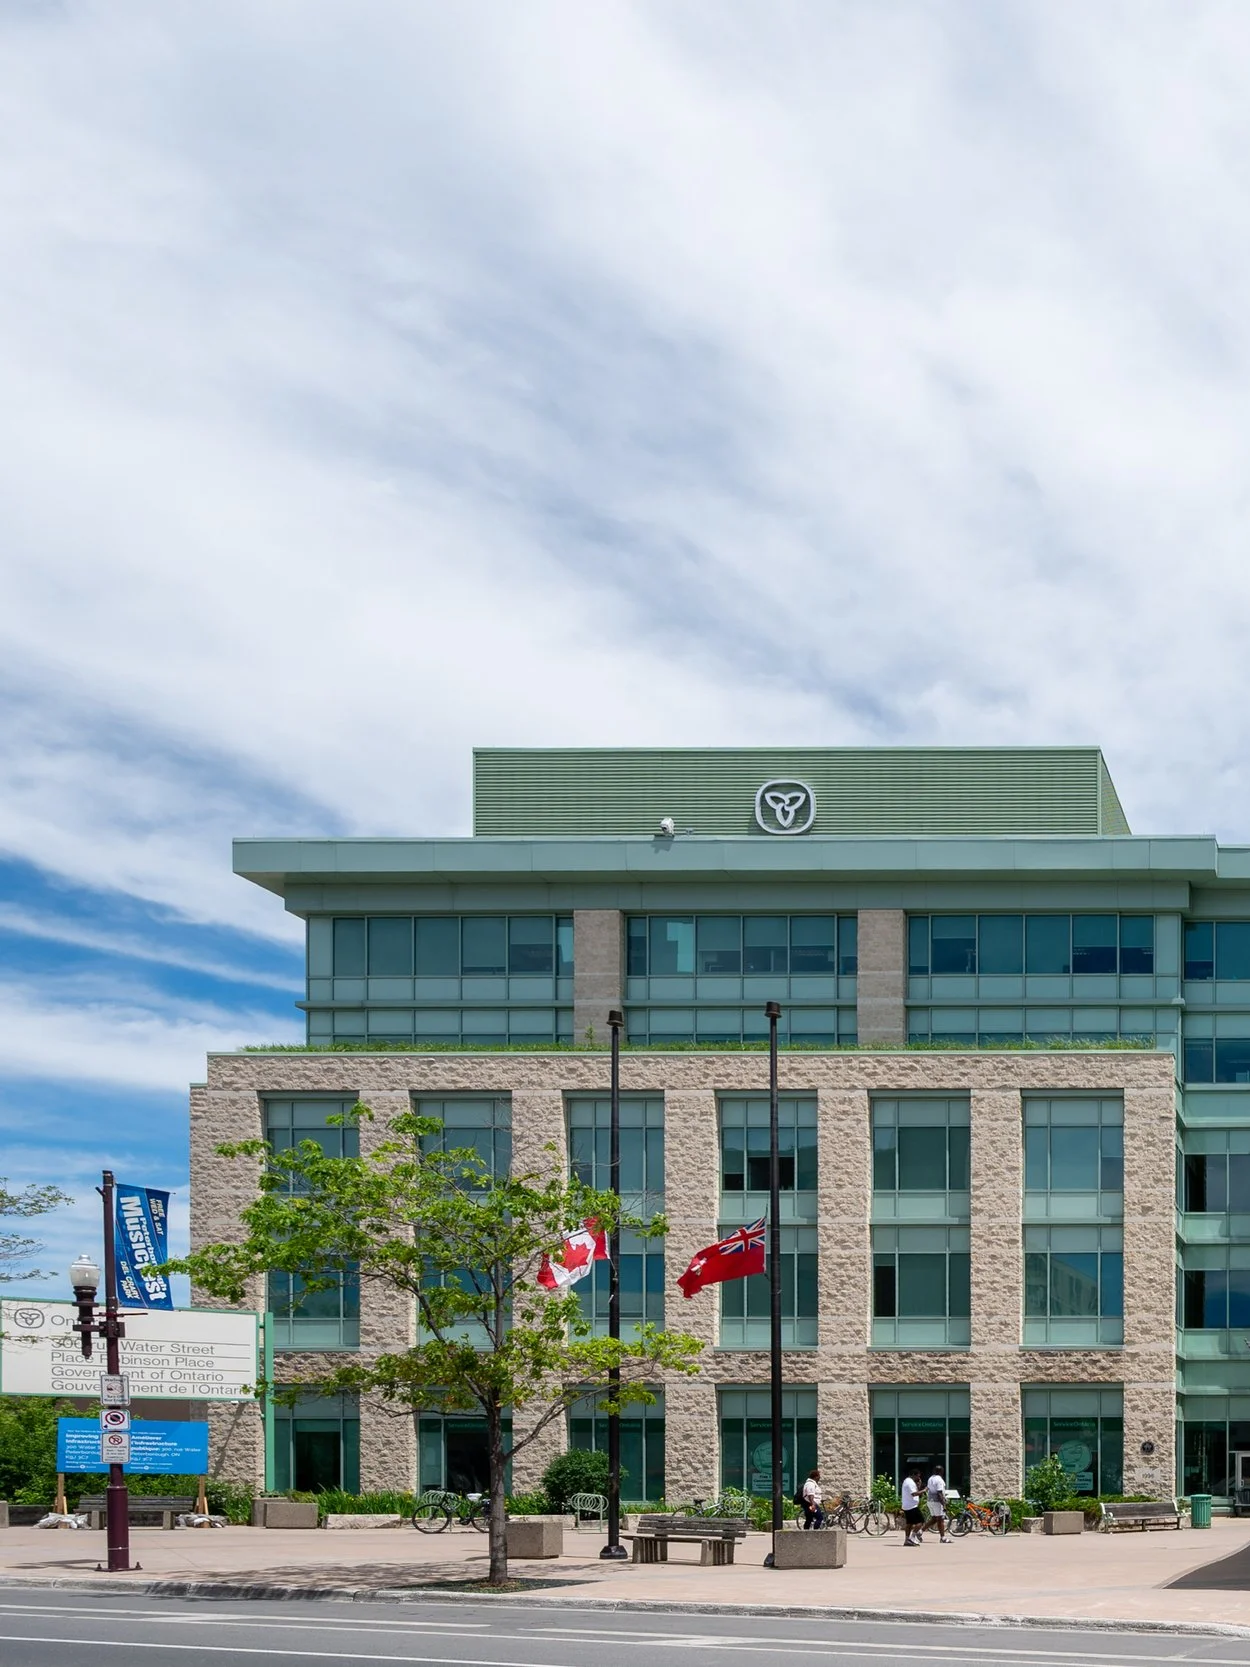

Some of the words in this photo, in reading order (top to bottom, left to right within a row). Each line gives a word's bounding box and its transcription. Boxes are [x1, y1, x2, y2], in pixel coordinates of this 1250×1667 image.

[149, 1198, 158, 1215] WED
[154, 1221, 164, 1236] SAT
[155, 1199, 165, 1217] FREE
[120, 1260, 128, 1276] DEL
[125, 1276, 141, 1300] CRARY
[120, 1279, 135, 1299] PARK
[120, 1340, 165, 1353] Water
[170, 1343, 215, 1355] Street
[51, 1351, 94, 1364] Place
[100, 1353, 170, 1367] Rbinson
[175, 1356, 215, 1369] Place
[51, 1365, 145, 1380] Governent
[150, 1370, 166, 1380] of
[170, 1370, 224, 1382] Ontario
[51, 1379, 165, 1394] Gouvement
[169, 1384, 187, 1394] de
[192, 1384, 250, 1395] l'Ontari
